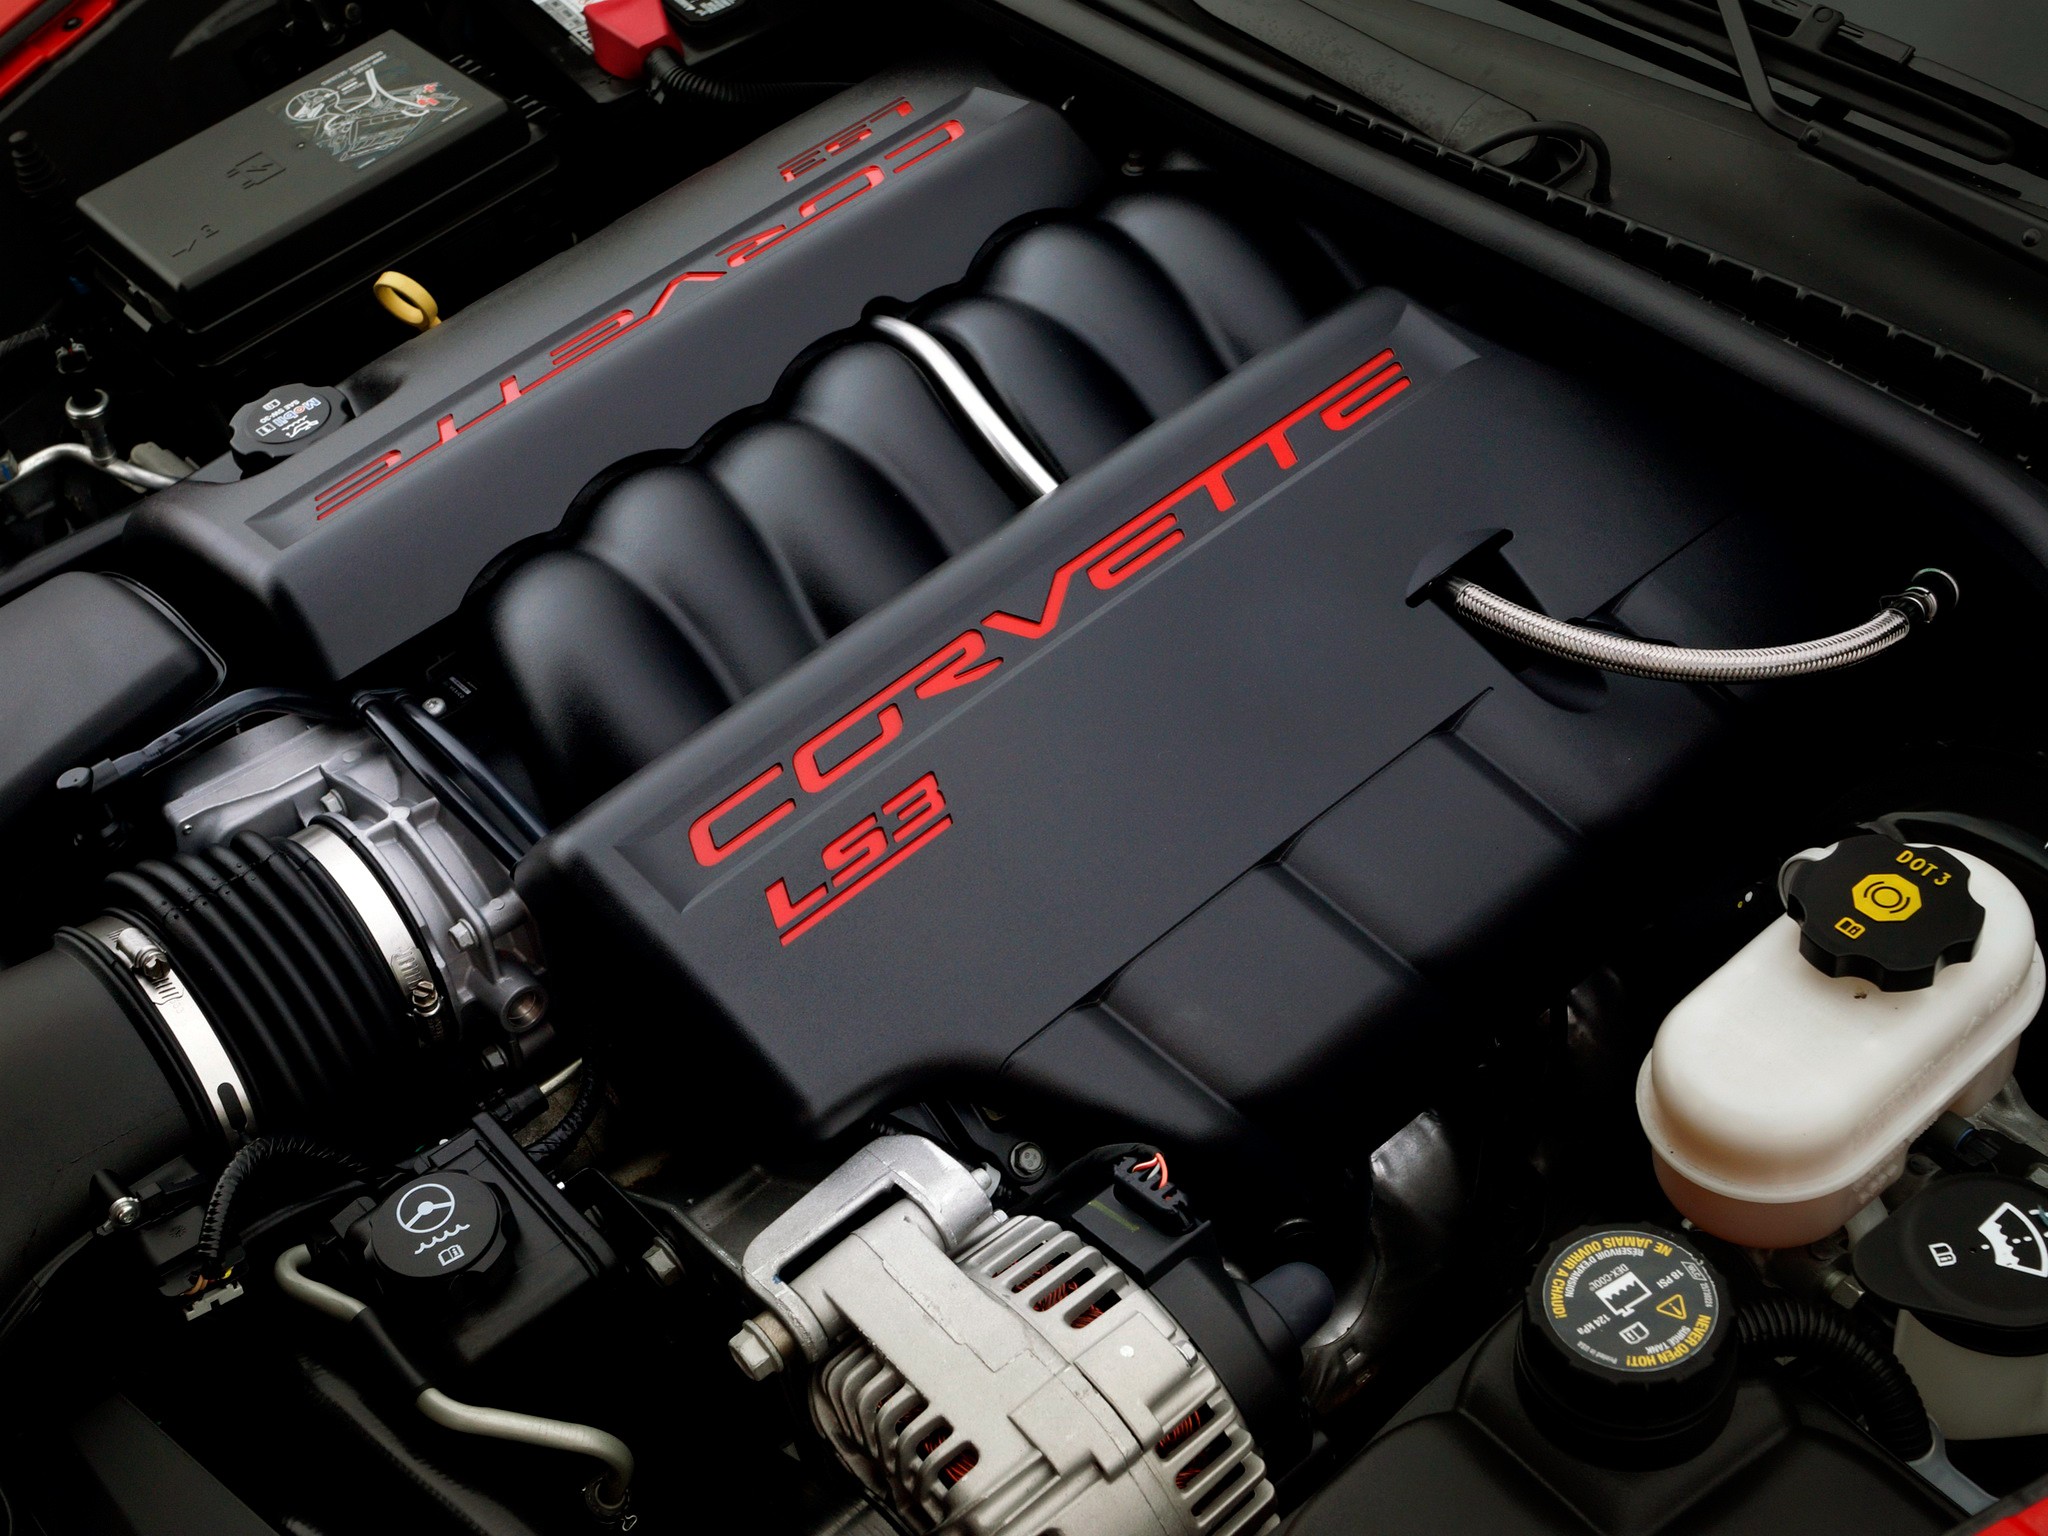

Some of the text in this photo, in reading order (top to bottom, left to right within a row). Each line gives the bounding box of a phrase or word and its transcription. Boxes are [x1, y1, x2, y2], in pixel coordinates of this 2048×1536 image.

[779, 98, 914, 182] LS3
[315, 120, 964, 521] CORVETTE
[272, 397, 321, 427] Mobil
[688, 348, 1411, 867] CORVETTE
[765, 770, 949, 932] LS3
[1895, 850, 1952, 886] DOT 3
[1562, 1241, 1602, 1270] OUVRIR
[1602, 1235, 1653, 1249] JAMAIS
[1653, 1242, 1673, 1257] NE
[1564, 1255, 1596, 1298] D'EXPANSION
[1655, 1269, 1685, 1290] 18 PSI
[1550, 1277, 1568, 1319] CHAUD!
[1576, 1313, 1611, 1336] 124 kPa
[1626, 1314, 1712, 1368] NEVER OPEN HOT!
[1645, 1325, 1692, 1355] SURGE TANK
